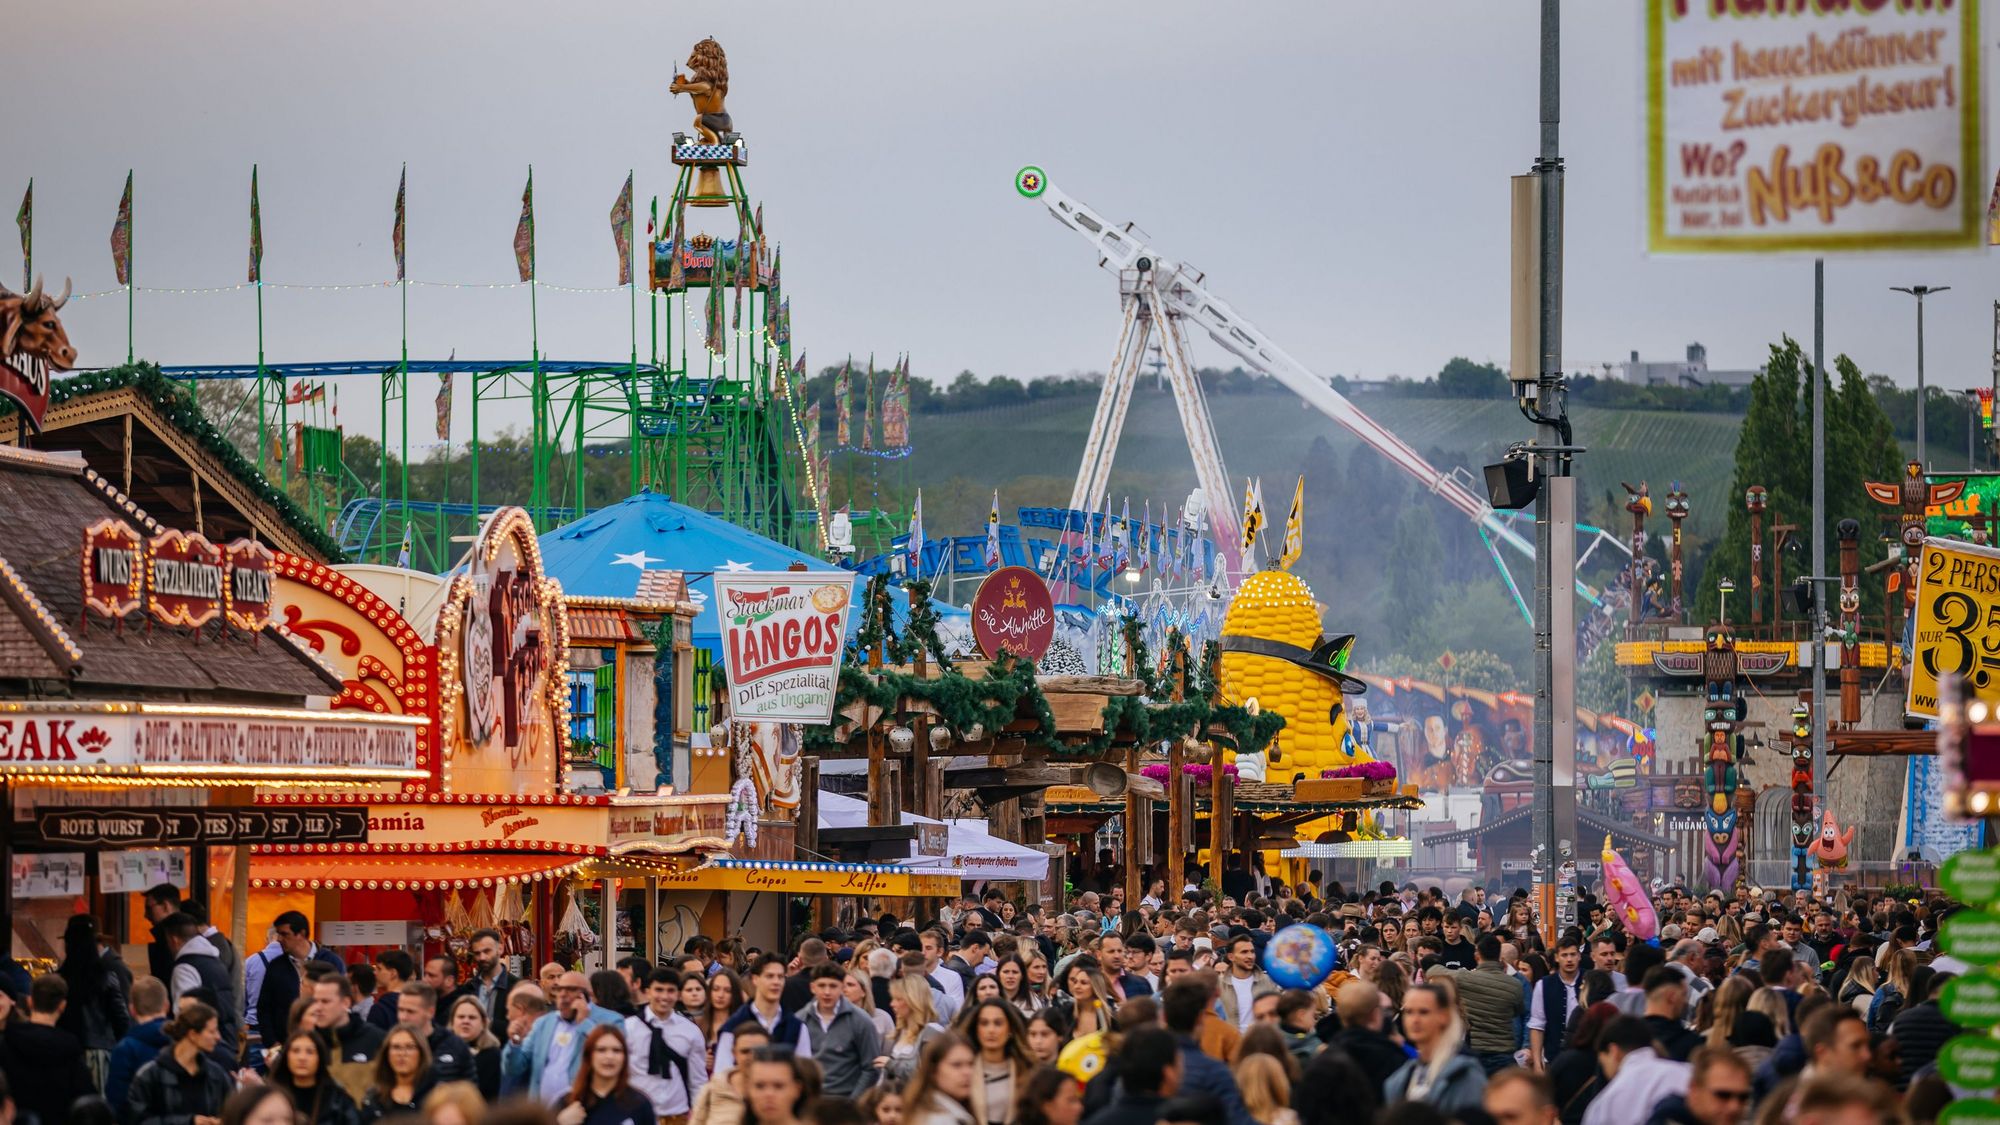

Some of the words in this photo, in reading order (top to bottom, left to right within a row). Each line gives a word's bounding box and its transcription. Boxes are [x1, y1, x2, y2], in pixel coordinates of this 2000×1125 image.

[1731, 28, 1946, 80] hauchdünner
[1720, 64, 1957, 130] Zuckerglasur!
[1681, 140, 1746, 178] Wo?
[1746, 142, 1957, 226] Nuß&Co
[99, 547, 133, 585] WURST
[1926, 551, 1945, 585] 2
[1949, 558, 2000, 593] PERS
[979, 604, 1000, 634] Die
[1918, 631, 1943, 643] NUR
[729, 613, 840, 685] LÁNGOS
[739, 681, 766, 705] DIE
[767, 673, 831, 696] Spezialität
[757, 698, 778, 713] aus
[781, 692, 828, 709] Ungarn!
[60, 819, 95, 836] ROTE
[97, 819, 145, 836] WURST
[746, 869, 787, 888] Crêpes
[840, 873, 887, 892] Kaffee
